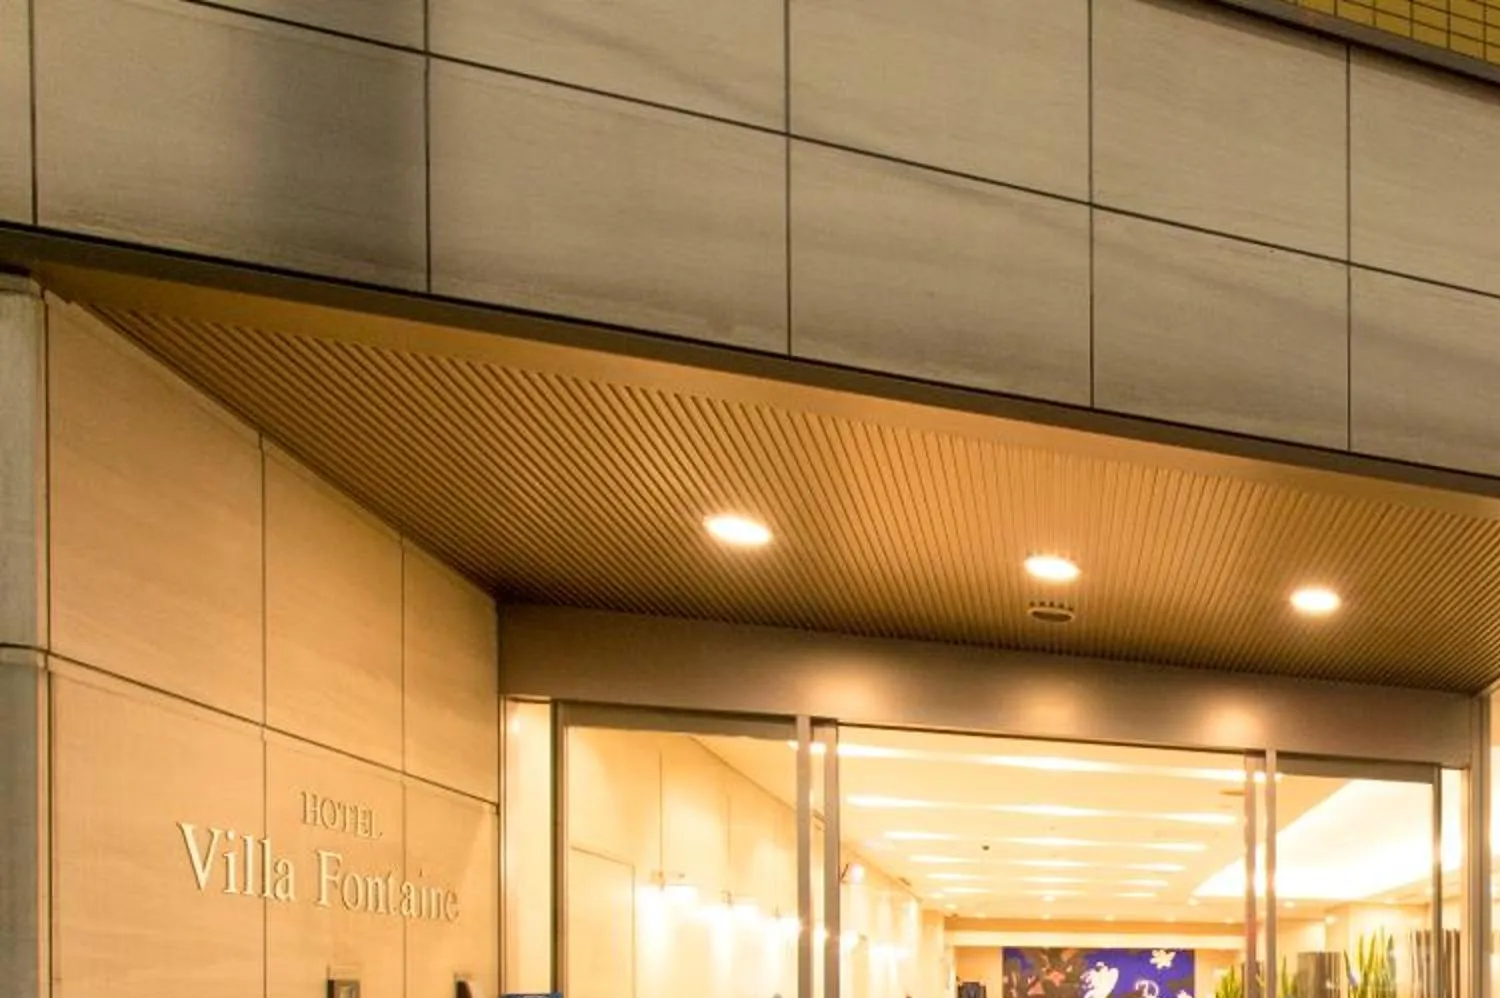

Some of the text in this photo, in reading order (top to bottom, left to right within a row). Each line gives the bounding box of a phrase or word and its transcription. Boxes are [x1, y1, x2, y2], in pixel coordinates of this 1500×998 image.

[301, 790, 383, 839] HOTEL
[176, 821, 460, 922] Villa Fontaine
